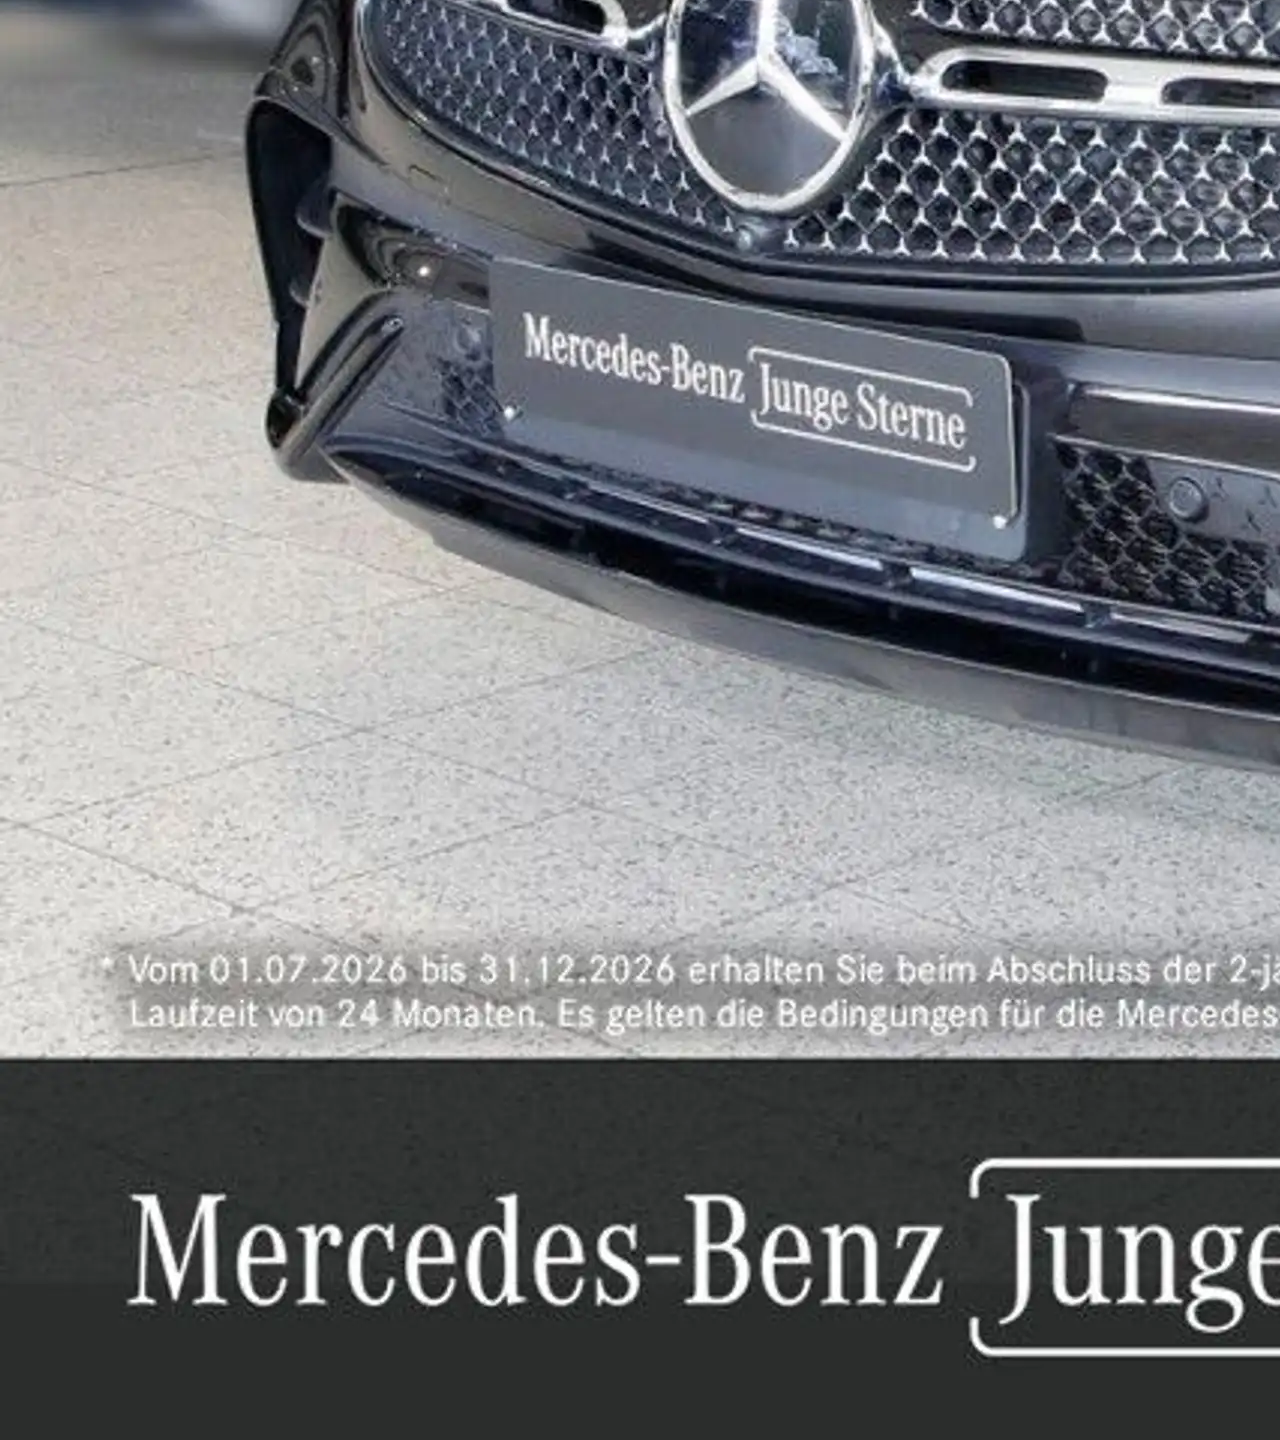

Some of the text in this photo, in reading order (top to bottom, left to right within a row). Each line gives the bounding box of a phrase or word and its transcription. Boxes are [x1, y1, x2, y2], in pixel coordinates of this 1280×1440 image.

[522, 311, 967, 450] Mercedes-Benz Junge Sterne
